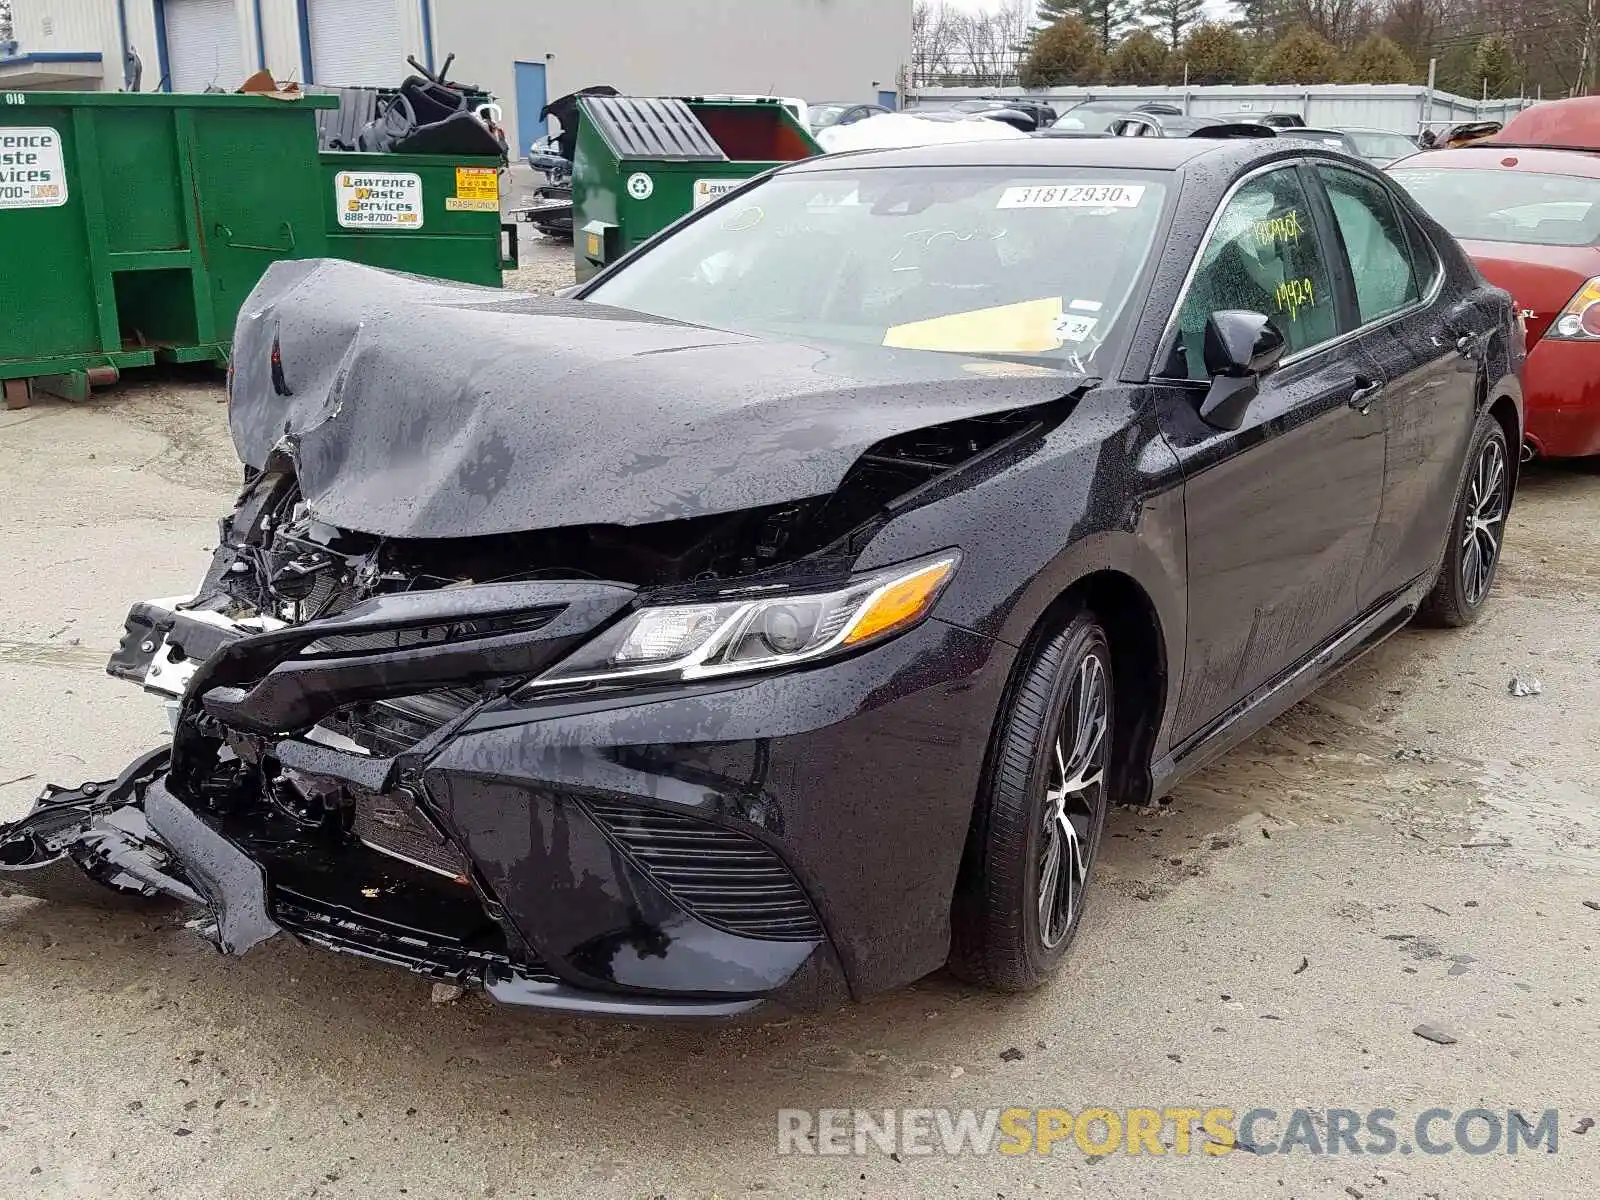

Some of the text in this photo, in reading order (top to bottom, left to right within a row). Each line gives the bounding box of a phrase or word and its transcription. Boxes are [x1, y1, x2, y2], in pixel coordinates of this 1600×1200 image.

[0, 136, 52, 147] ence
[0, 152, 37, 165] ste
[343, 175, 415, 187] Lawrence
[355, 188, 404, 199] Waste
[699, 182, 740, 194] Lawr
[347, 200, 413, 211] Services
